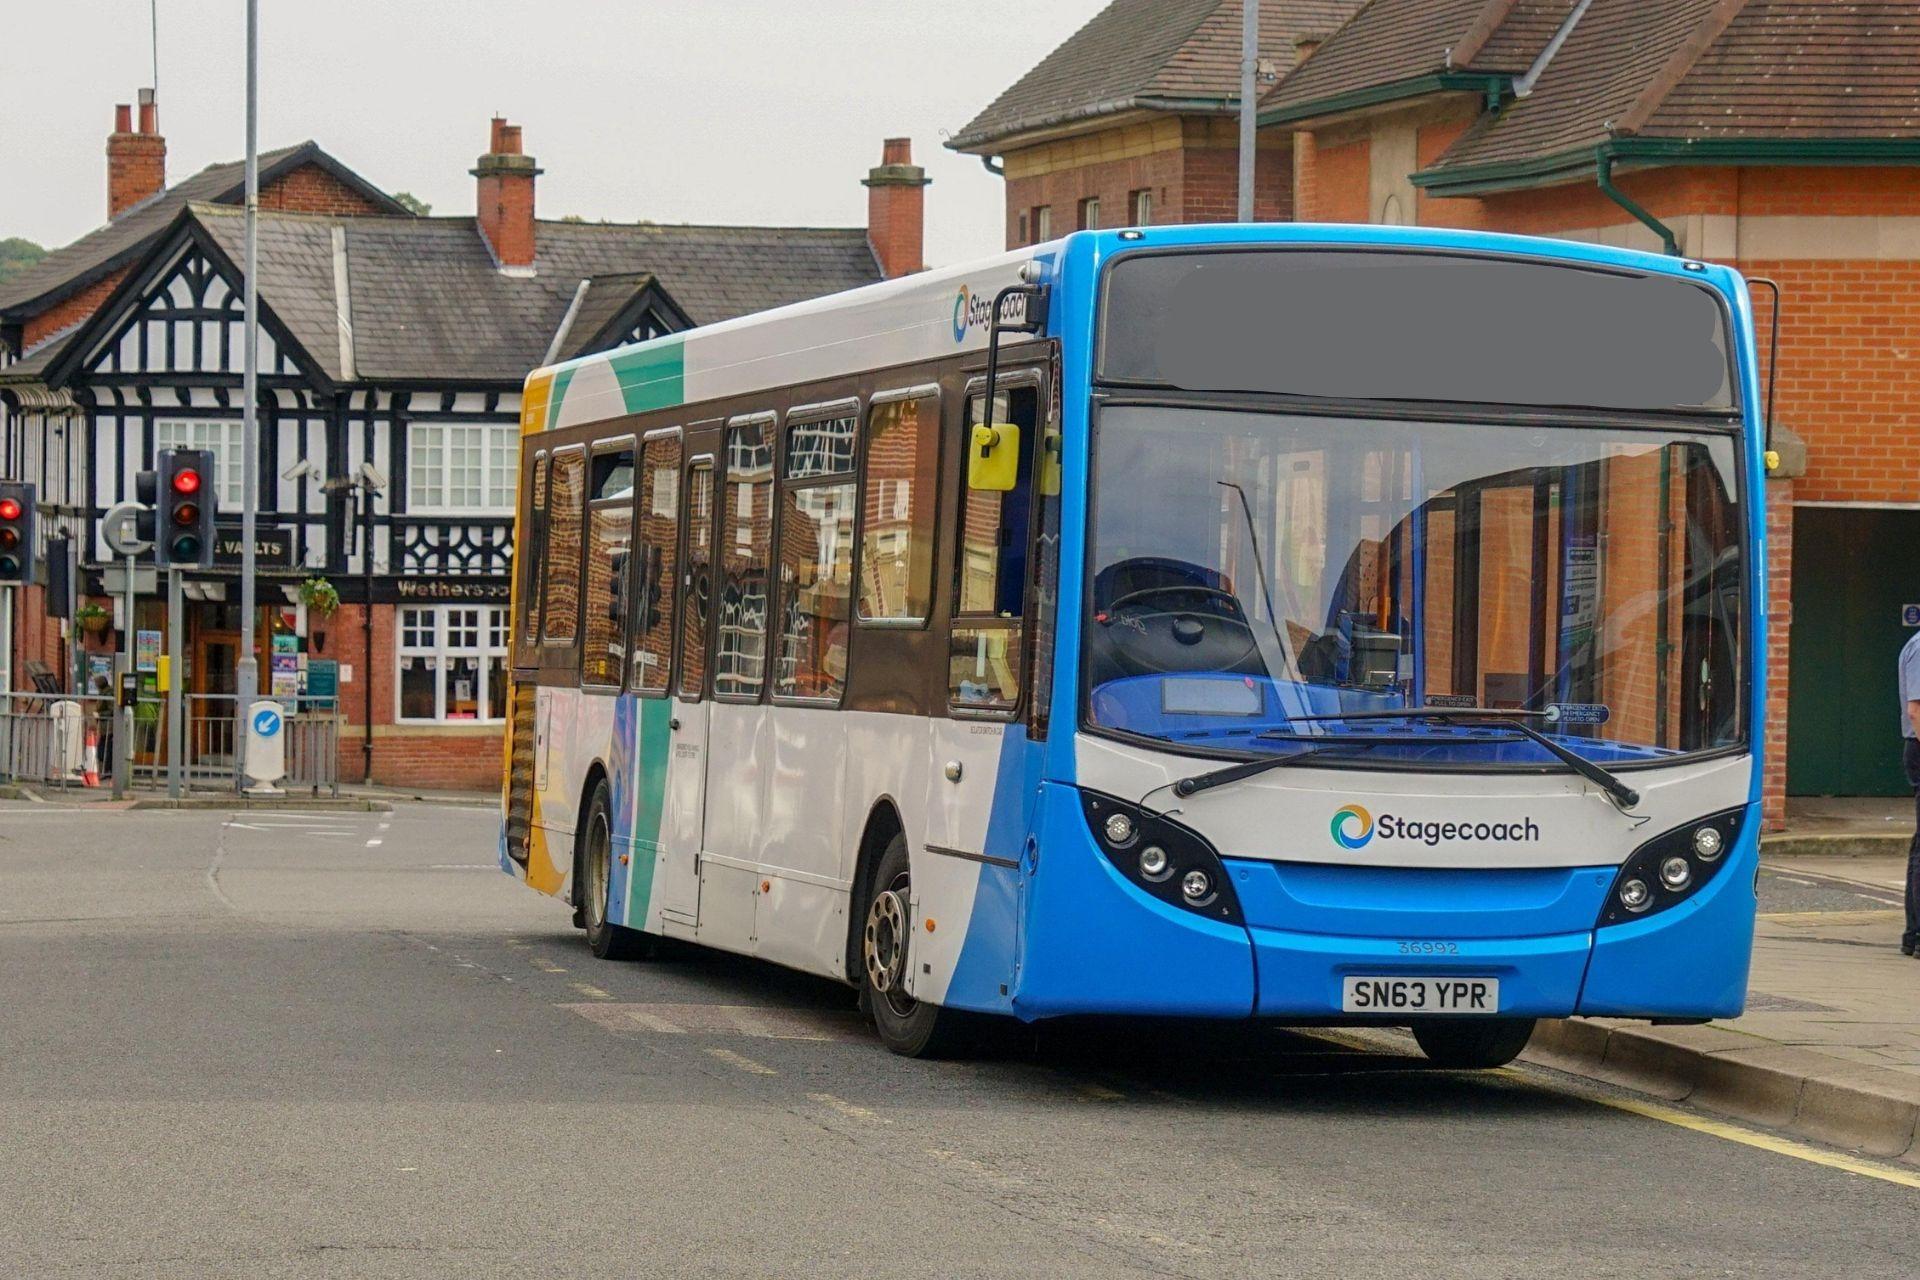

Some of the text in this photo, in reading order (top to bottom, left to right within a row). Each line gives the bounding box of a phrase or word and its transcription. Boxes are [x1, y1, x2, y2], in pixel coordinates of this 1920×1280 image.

[968, 293, 1026, 331] Stagoac
[224, 541, 281, 555] VALTS
[398, 581, 510, 597] Wetherspo
[1377, 814, 1540, 846] Stagecoach
[1397, 942, 1459, 955] 36992
[1354, 981, 1487, 1008] SN63 YPR
